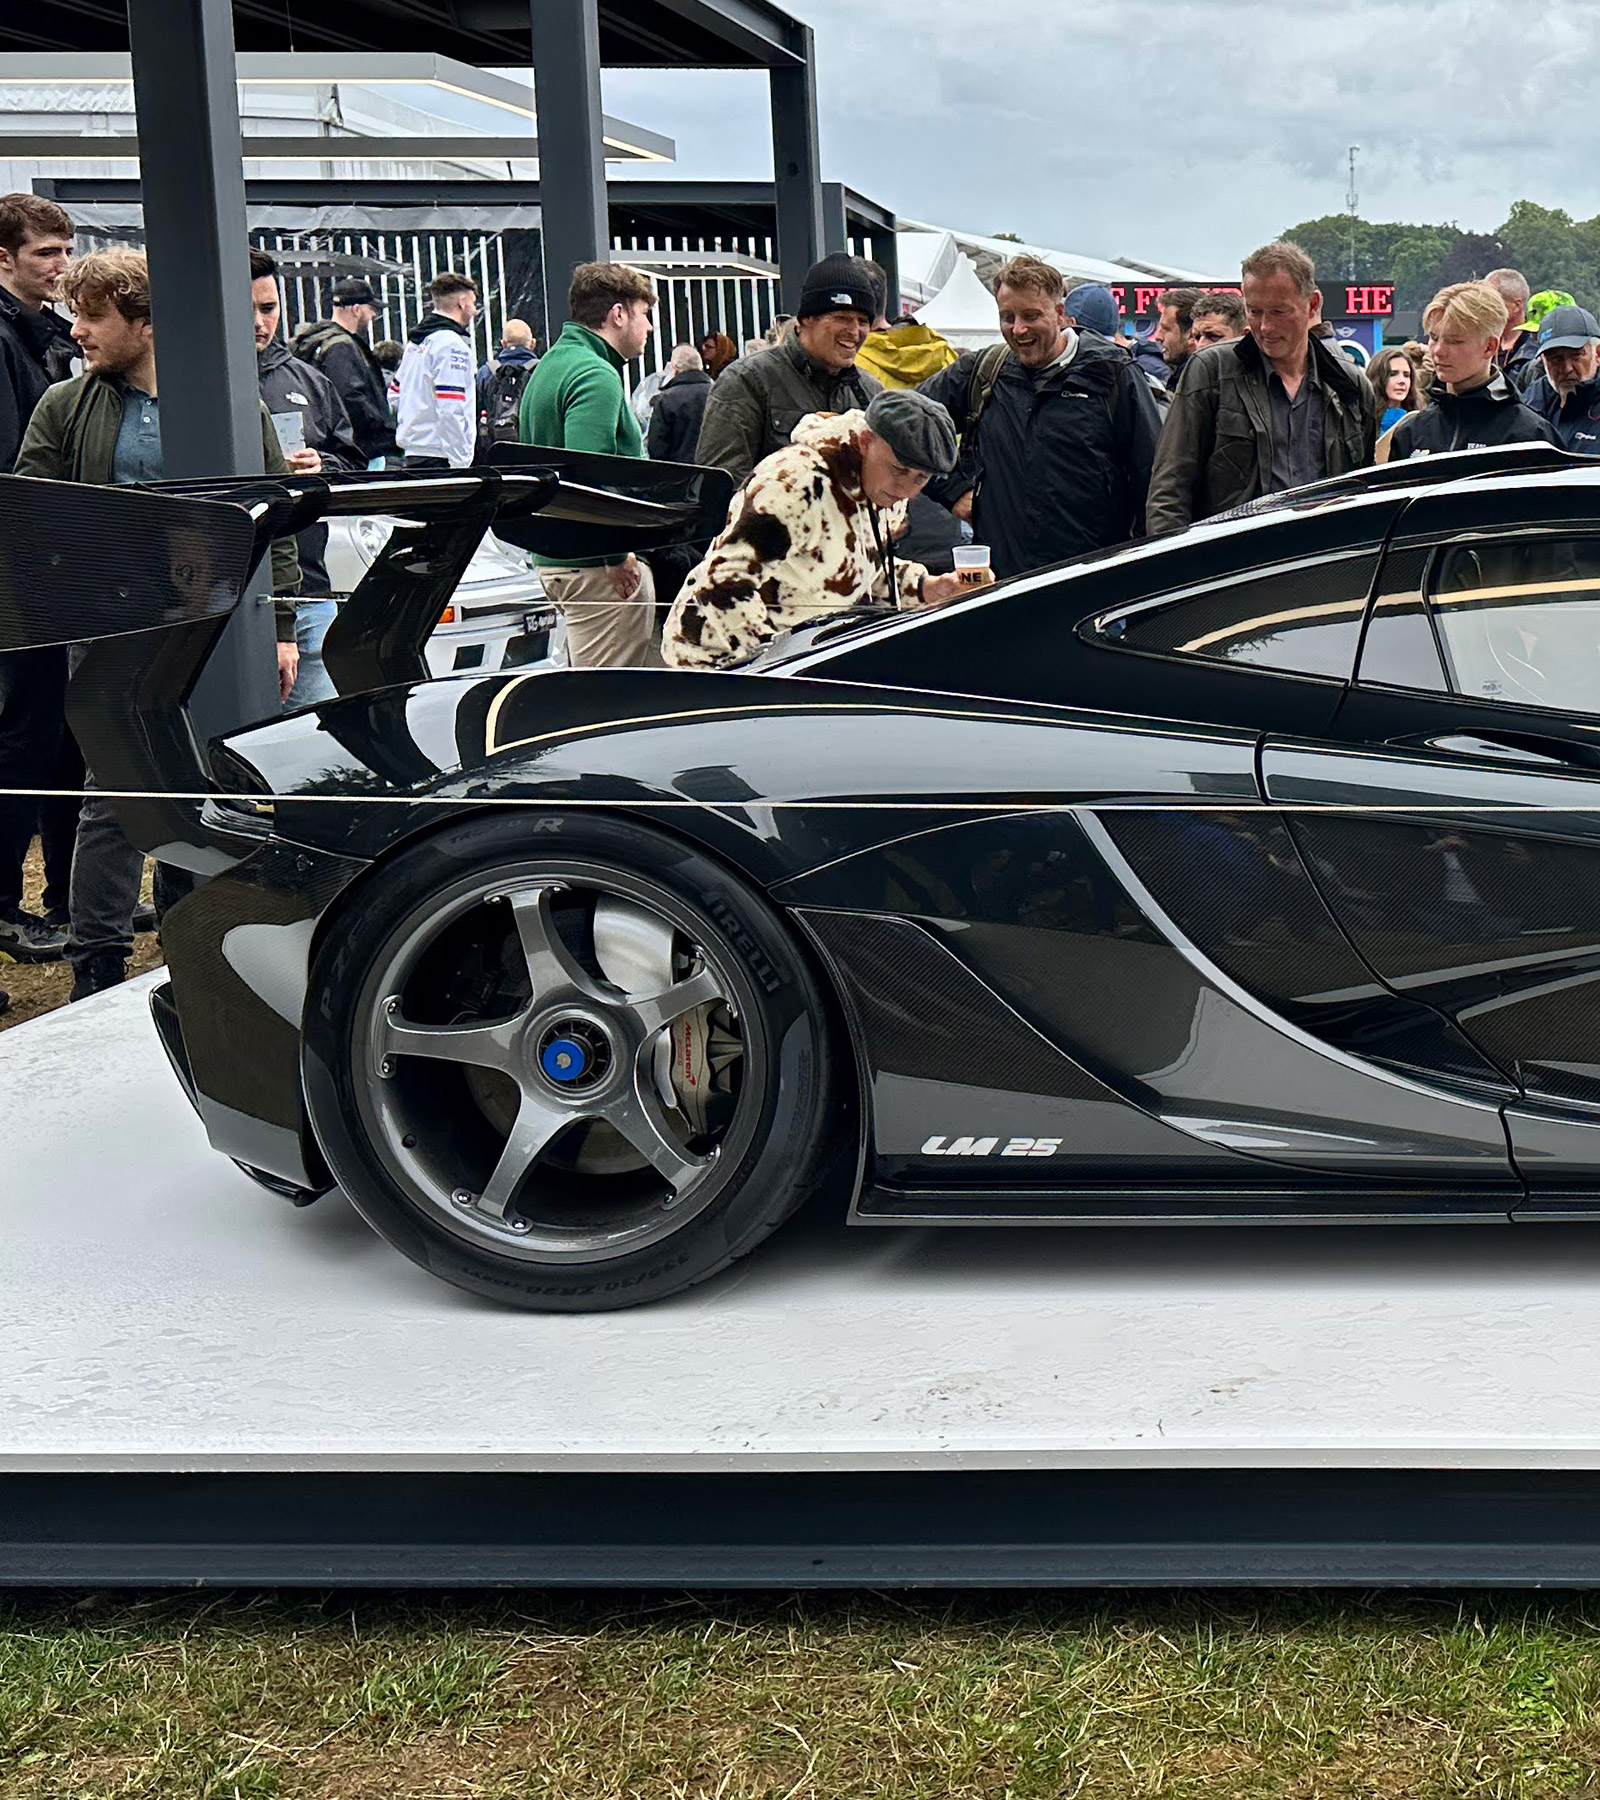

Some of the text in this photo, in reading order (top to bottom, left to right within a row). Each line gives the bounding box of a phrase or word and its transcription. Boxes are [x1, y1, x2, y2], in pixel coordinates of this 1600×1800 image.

[1345, 286, 1396, 314] HE
[533, 817, 564, 833] R
[700, 886, 783, 993] PIRELLI
[921, 1136, 1063, 1156] LM 25
